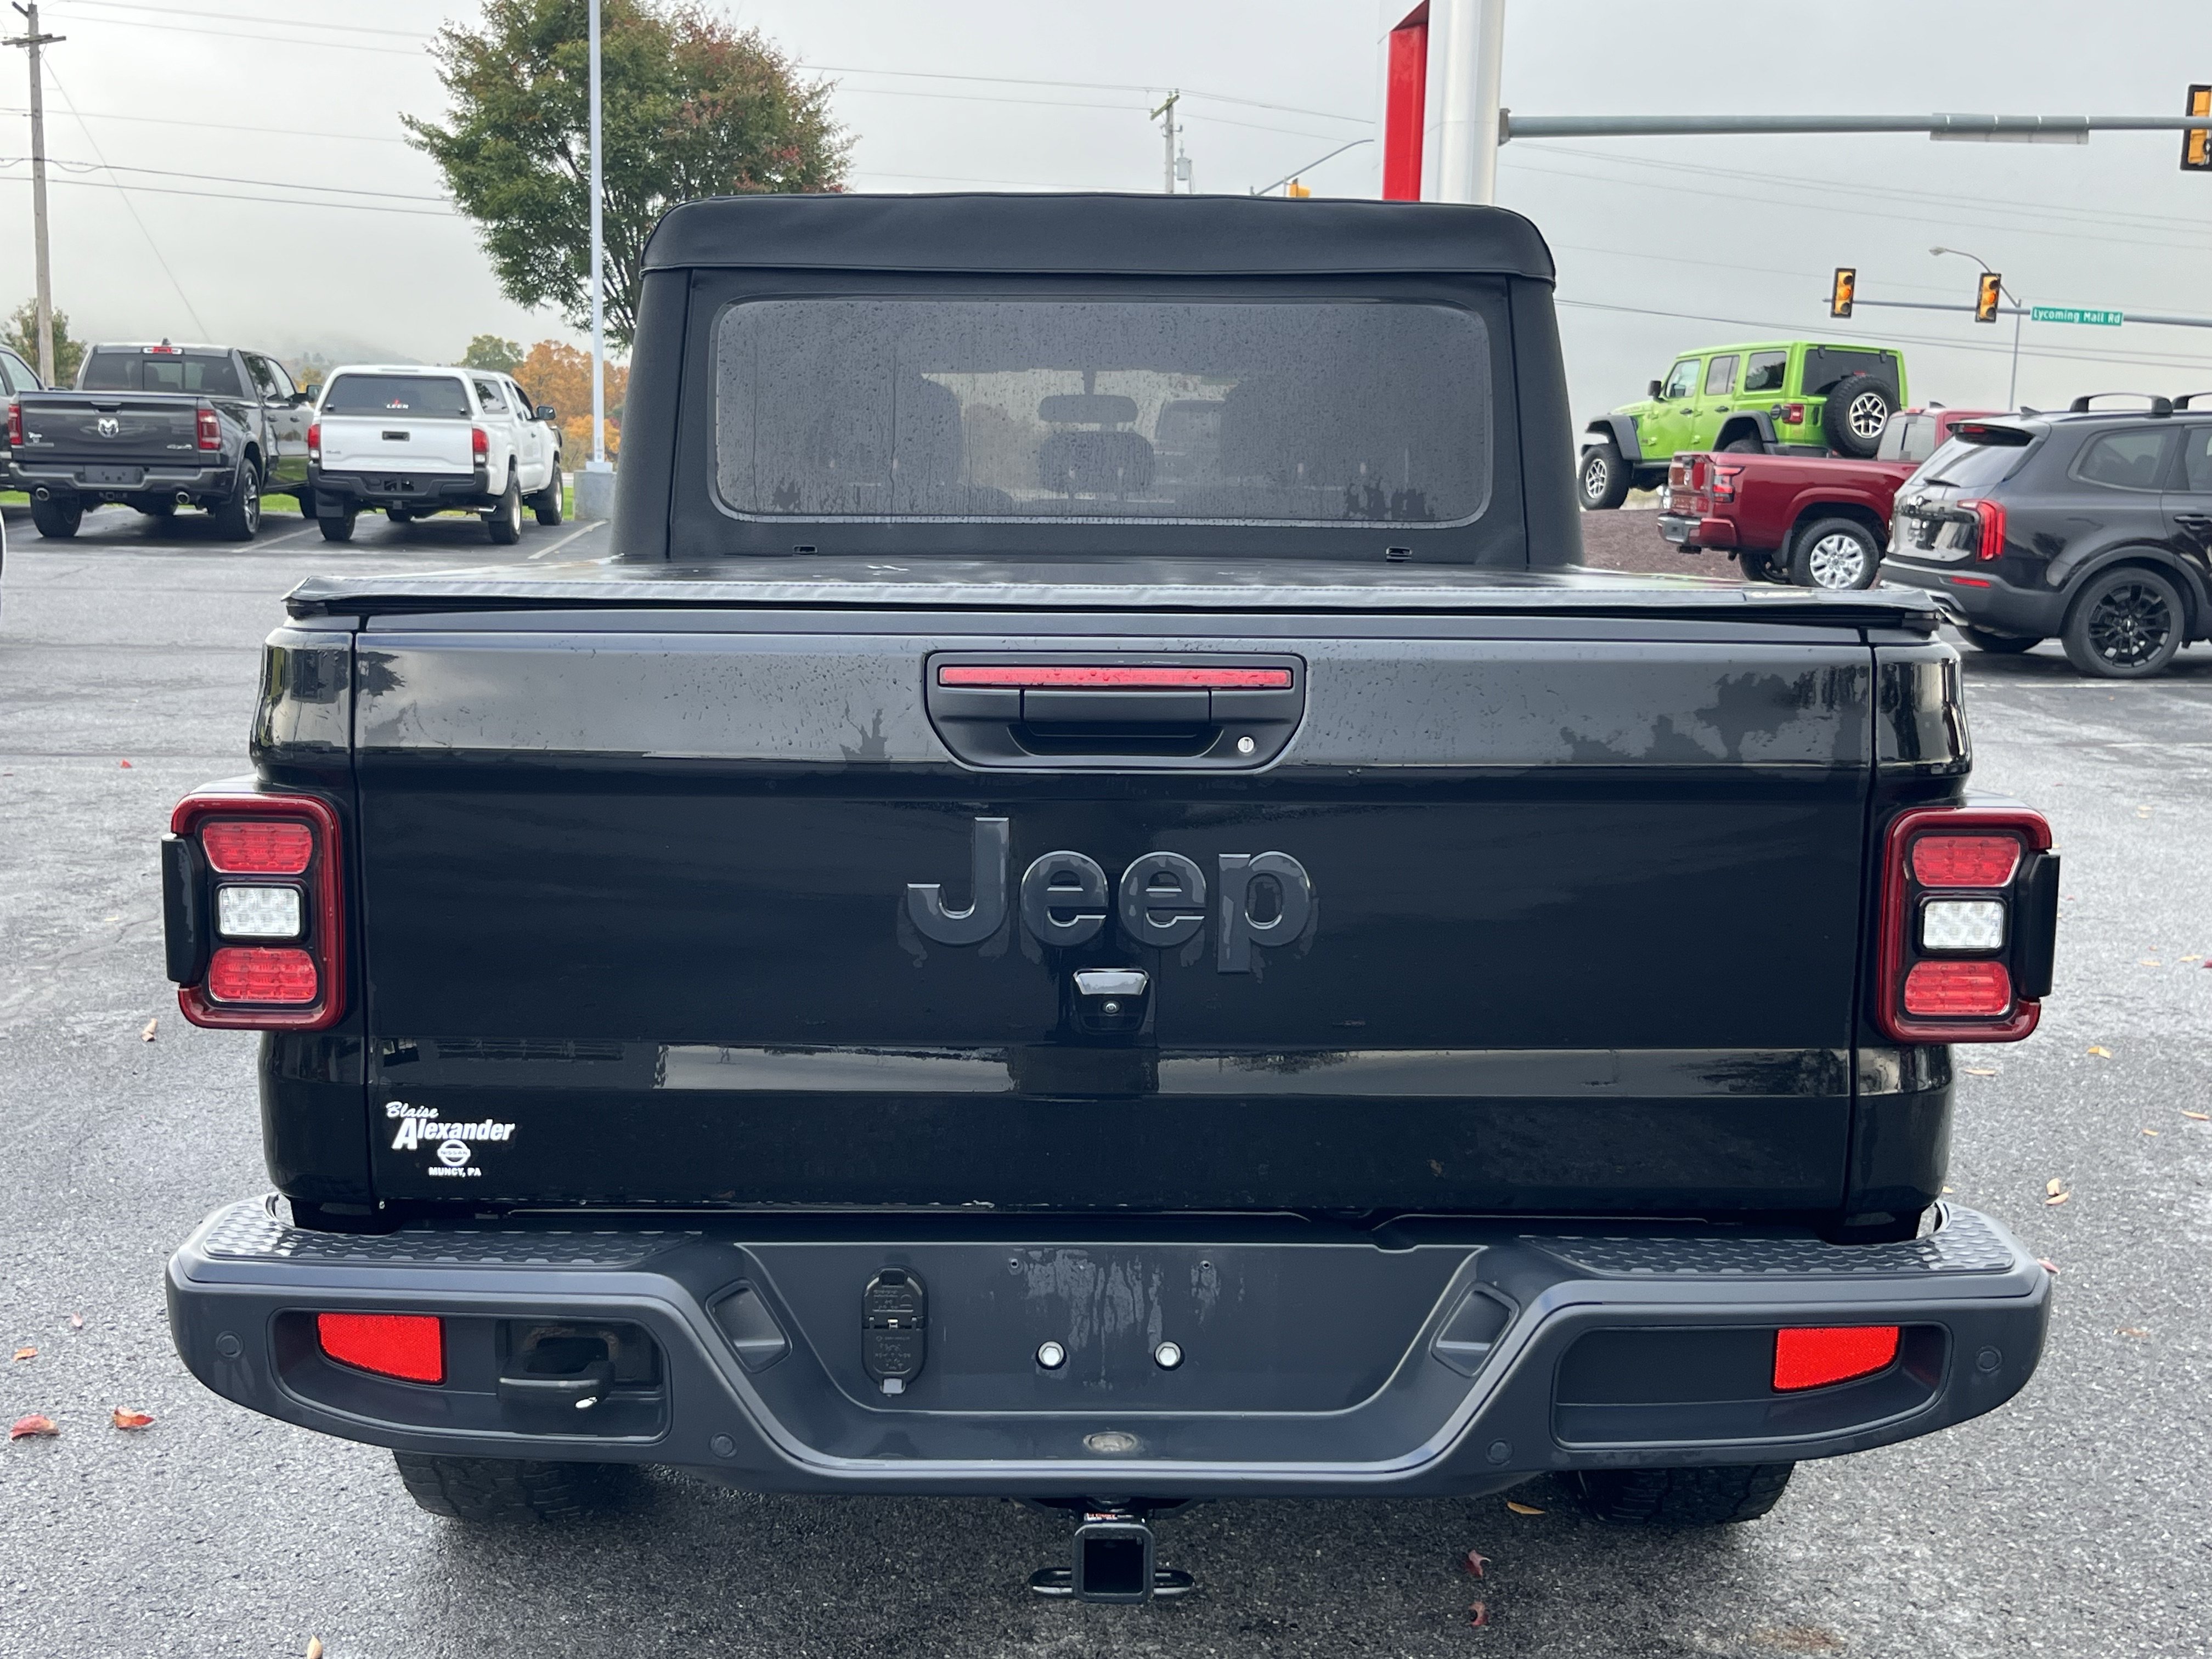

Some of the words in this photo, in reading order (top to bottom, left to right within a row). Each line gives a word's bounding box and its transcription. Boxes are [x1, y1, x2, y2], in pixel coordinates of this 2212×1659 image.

[2034, 308, 2079, 323] Lycoming
[2083, 312, 2104, 323] Mall
[2108, 312, 2120, 324] Rd
[907, 817, 1312, 973] Jeep
[386, 1101, 439, 1118] Blaise
[391, 1117, 515, 1150] Alexander
[428, 1167, 466, 1178] MUNCY,
[467, 1167, 482, 1176] PA
